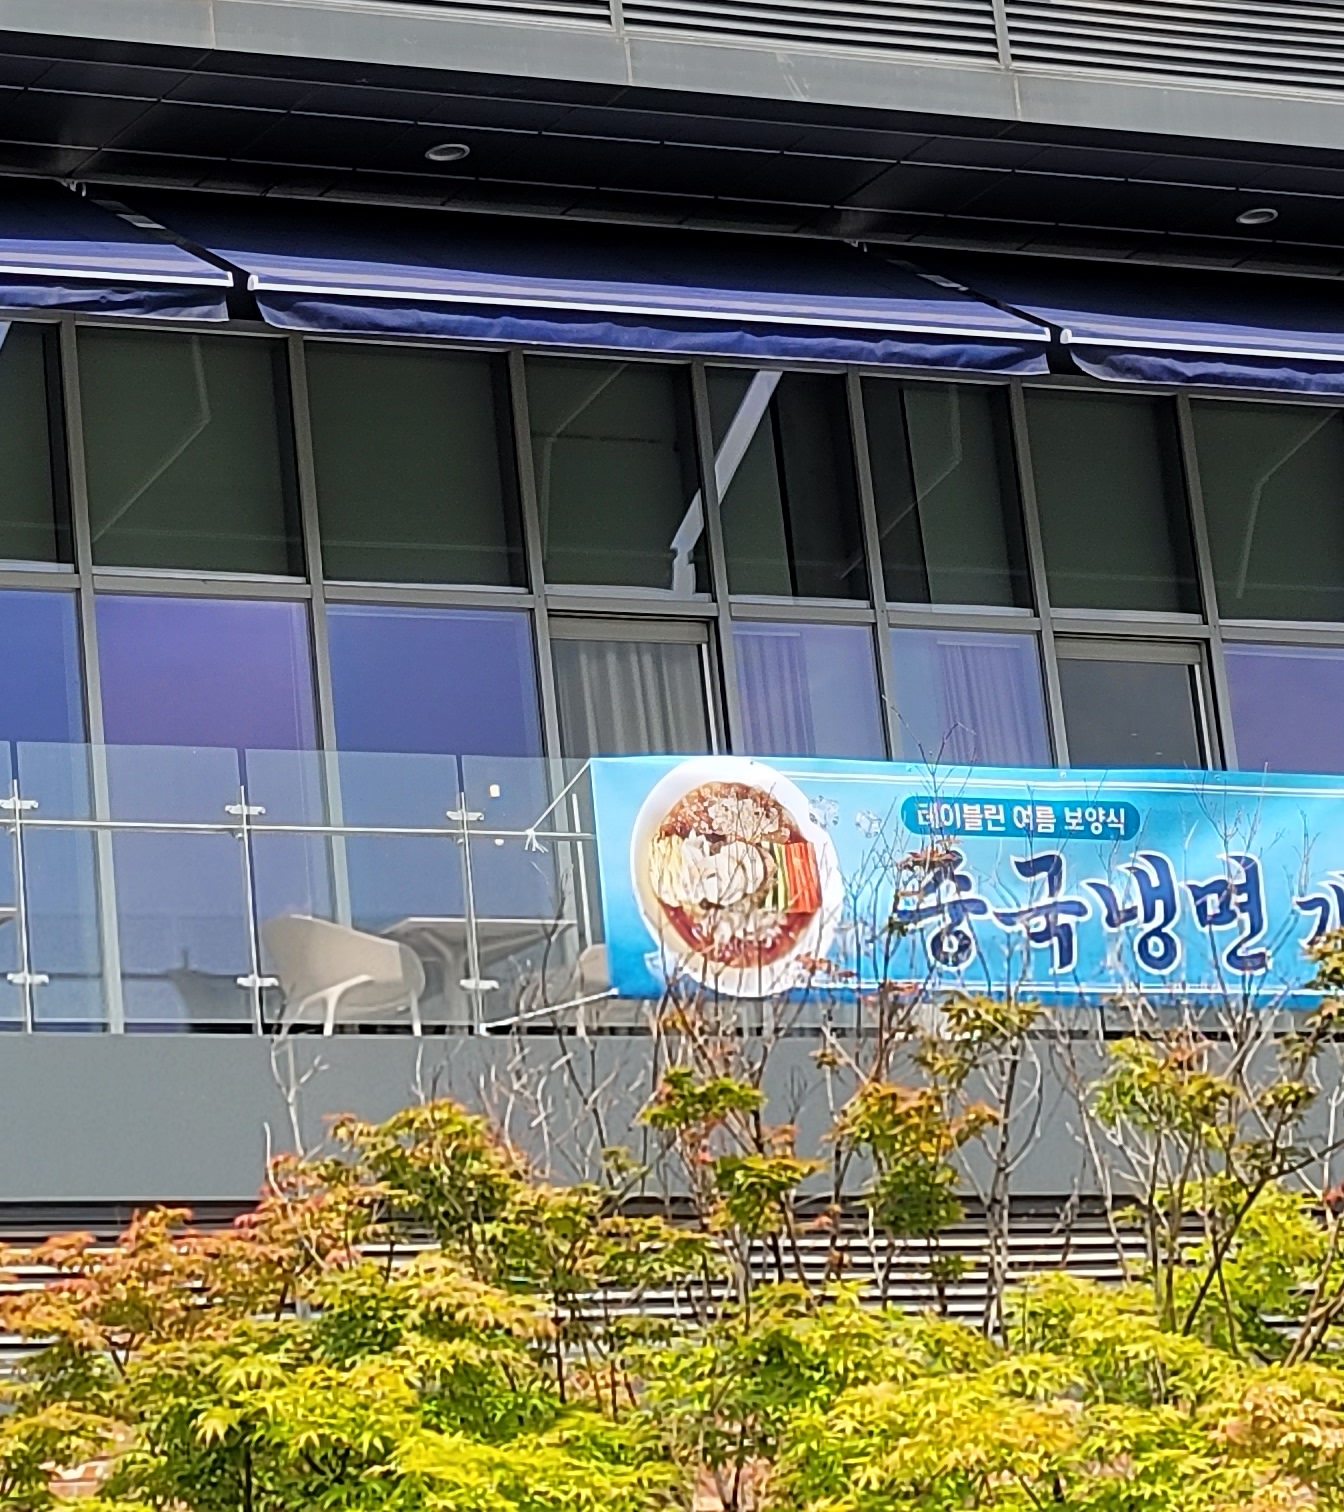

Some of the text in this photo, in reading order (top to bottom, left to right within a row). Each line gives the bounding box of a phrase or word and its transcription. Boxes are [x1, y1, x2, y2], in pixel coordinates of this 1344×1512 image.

[917, 802, 1126, 836] 테이블린 여름 보양식
[894, 850, 1270, 971] 중국냉면
